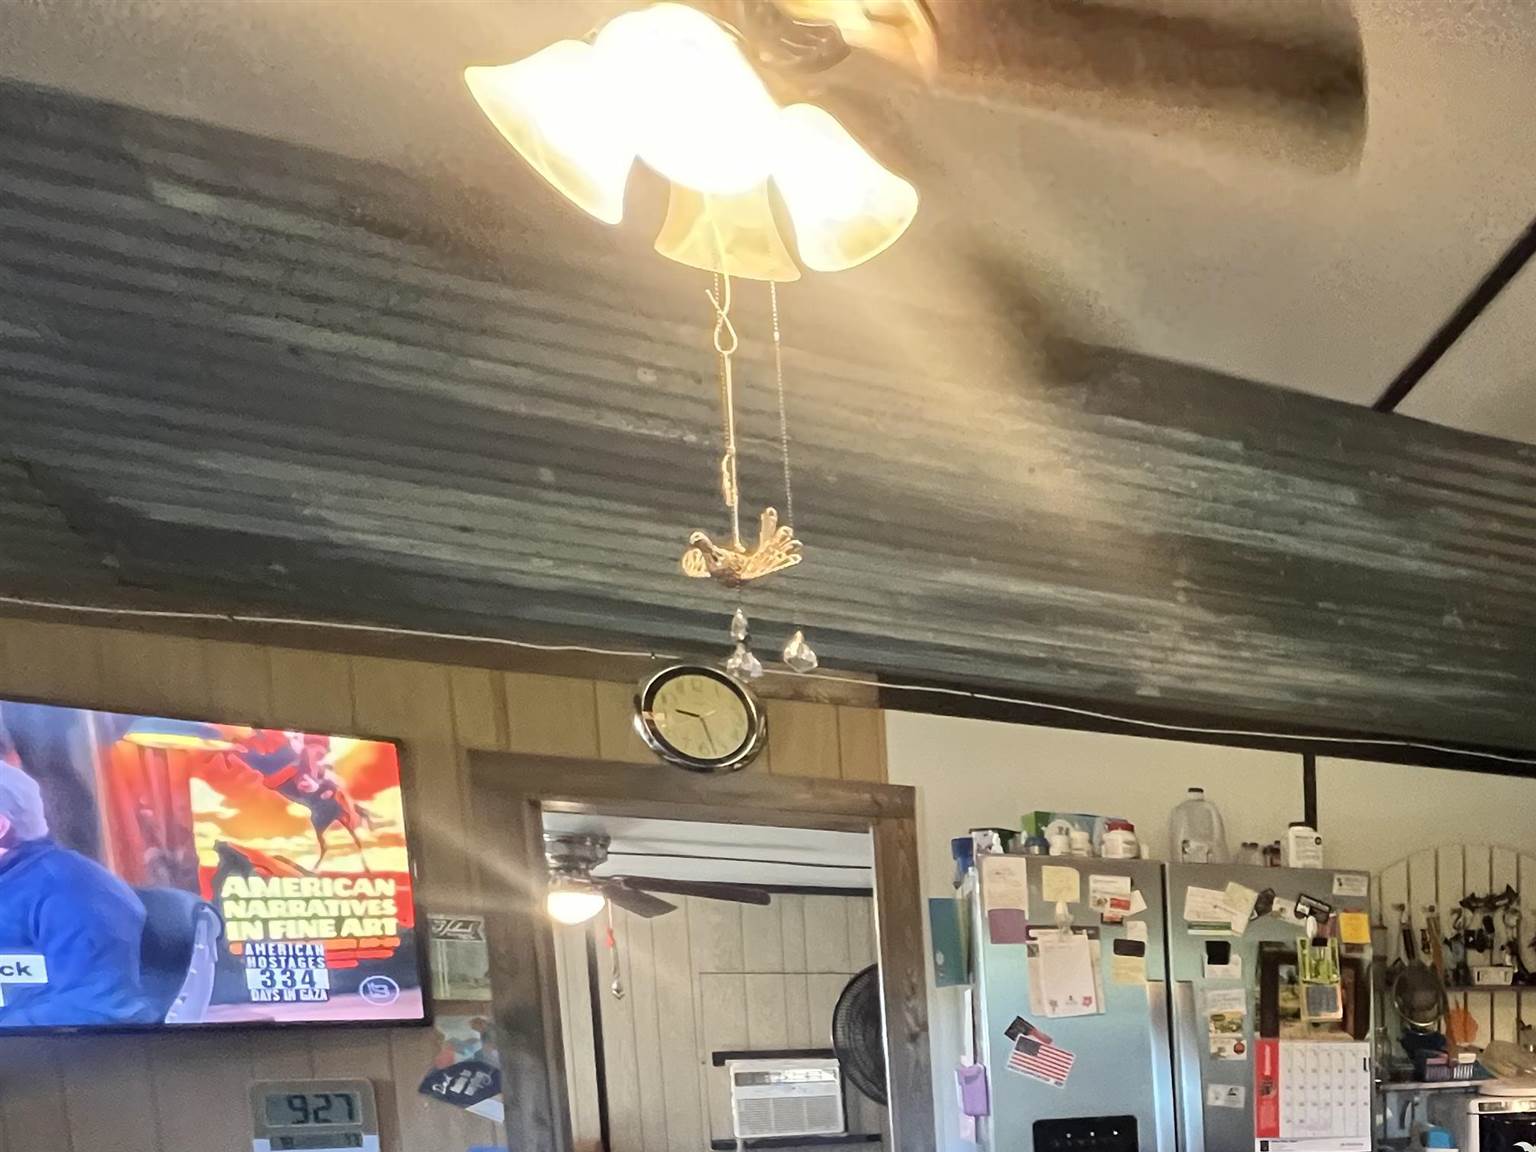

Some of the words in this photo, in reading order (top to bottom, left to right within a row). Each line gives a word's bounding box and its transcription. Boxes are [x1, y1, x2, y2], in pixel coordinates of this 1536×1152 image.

[221, 876, 396, 898] AMERICAN
[223, 898, 398, 919] NARRATIVES
[226, 919, 264, 941] IN
[268, 918, 337, 940] FINE
[340, 917, 398, 937] ART
[244, 942, 325, 956] AMERICAN
[245, 956, 326, 969] HOSTAGES
[259, 969, 316, 988] 334
[250, 988, 281, 1002] DAYS
[283, 988, 297, 1001] IN
[300, 988, 328, 1001] GAZA
